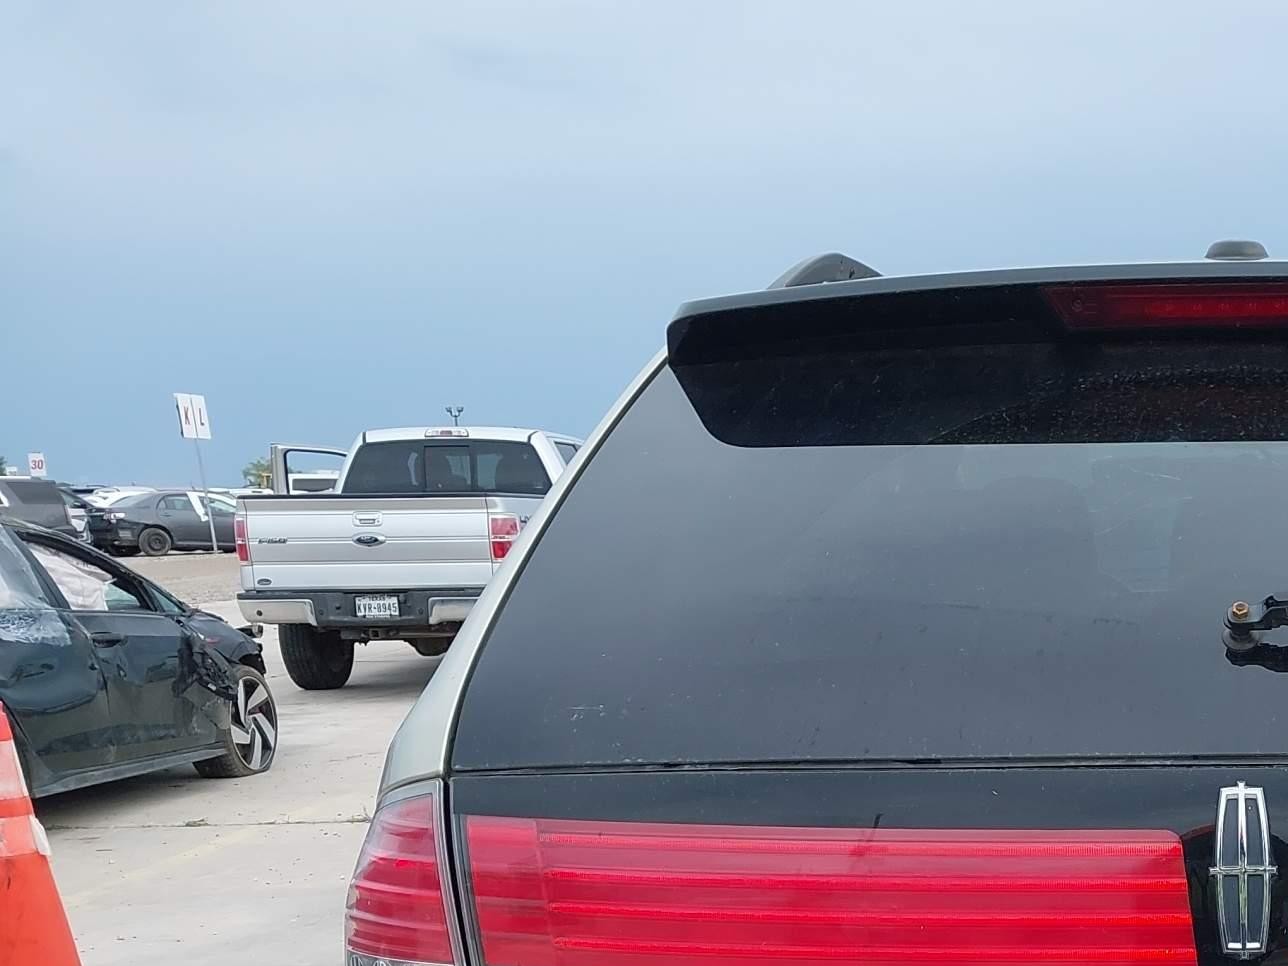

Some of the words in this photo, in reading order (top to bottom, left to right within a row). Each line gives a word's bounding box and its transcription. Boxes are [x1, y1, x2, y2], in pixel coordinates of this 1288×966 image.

[184, 406, 191, 425] K
[199, 407, 205, 426] L
[31, 459, 43, 470] 30
